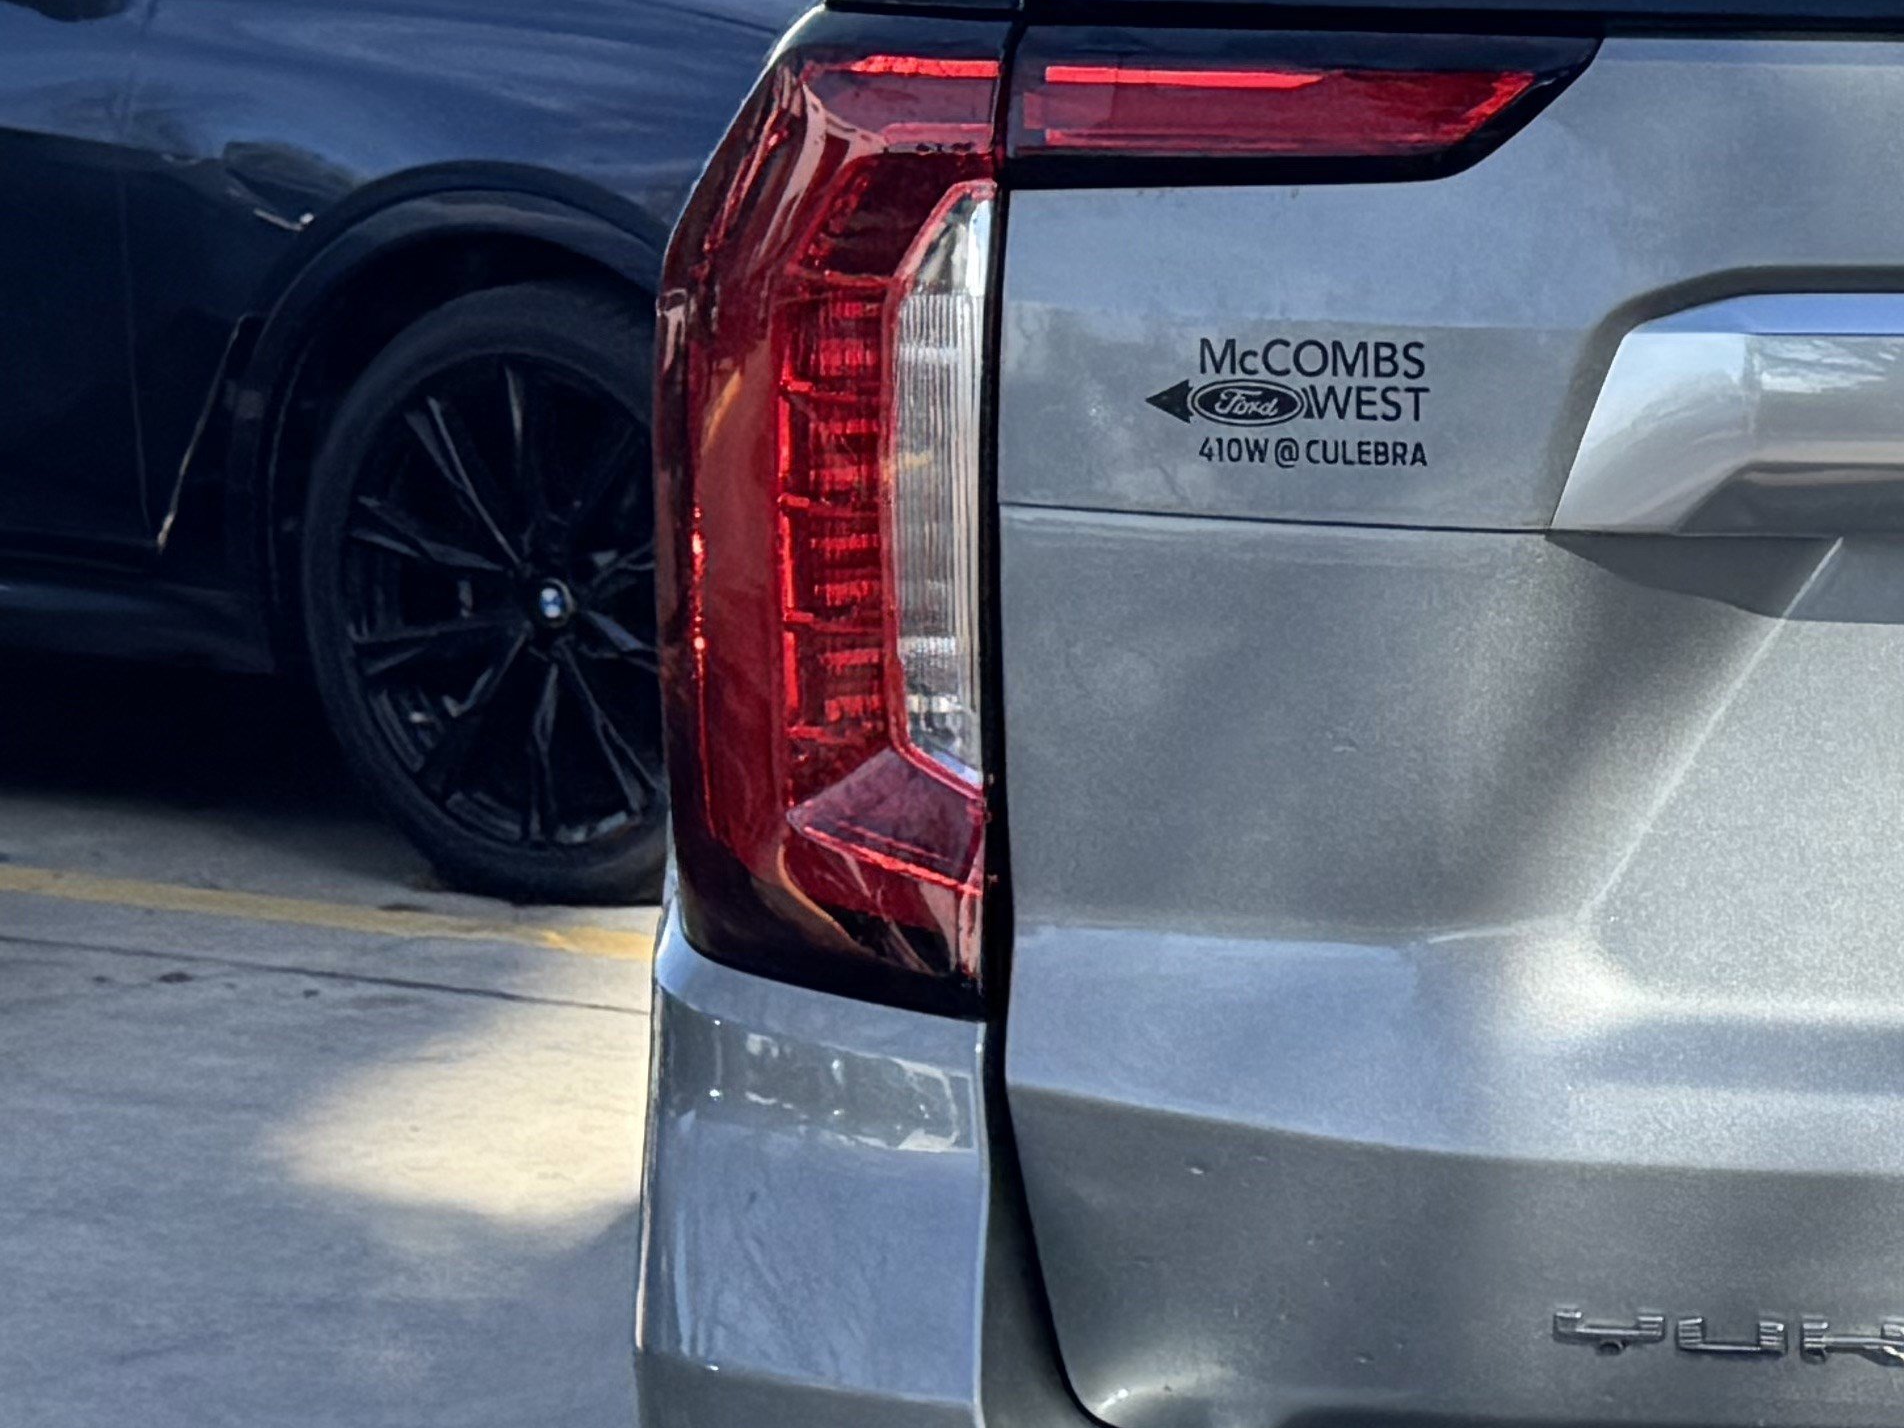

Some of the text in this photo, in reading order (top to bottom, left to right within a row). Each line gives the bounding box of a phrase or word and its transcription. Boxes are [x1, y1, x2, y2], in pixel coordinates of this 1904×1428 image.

[1199, 338, 1426, 380] McCOMBS
[1214, 389, 1280, 417] Ford
[1308, 385, 1430, 422] WEST
[1199, 437, 1428, 468] 410W @ CULEBRA
